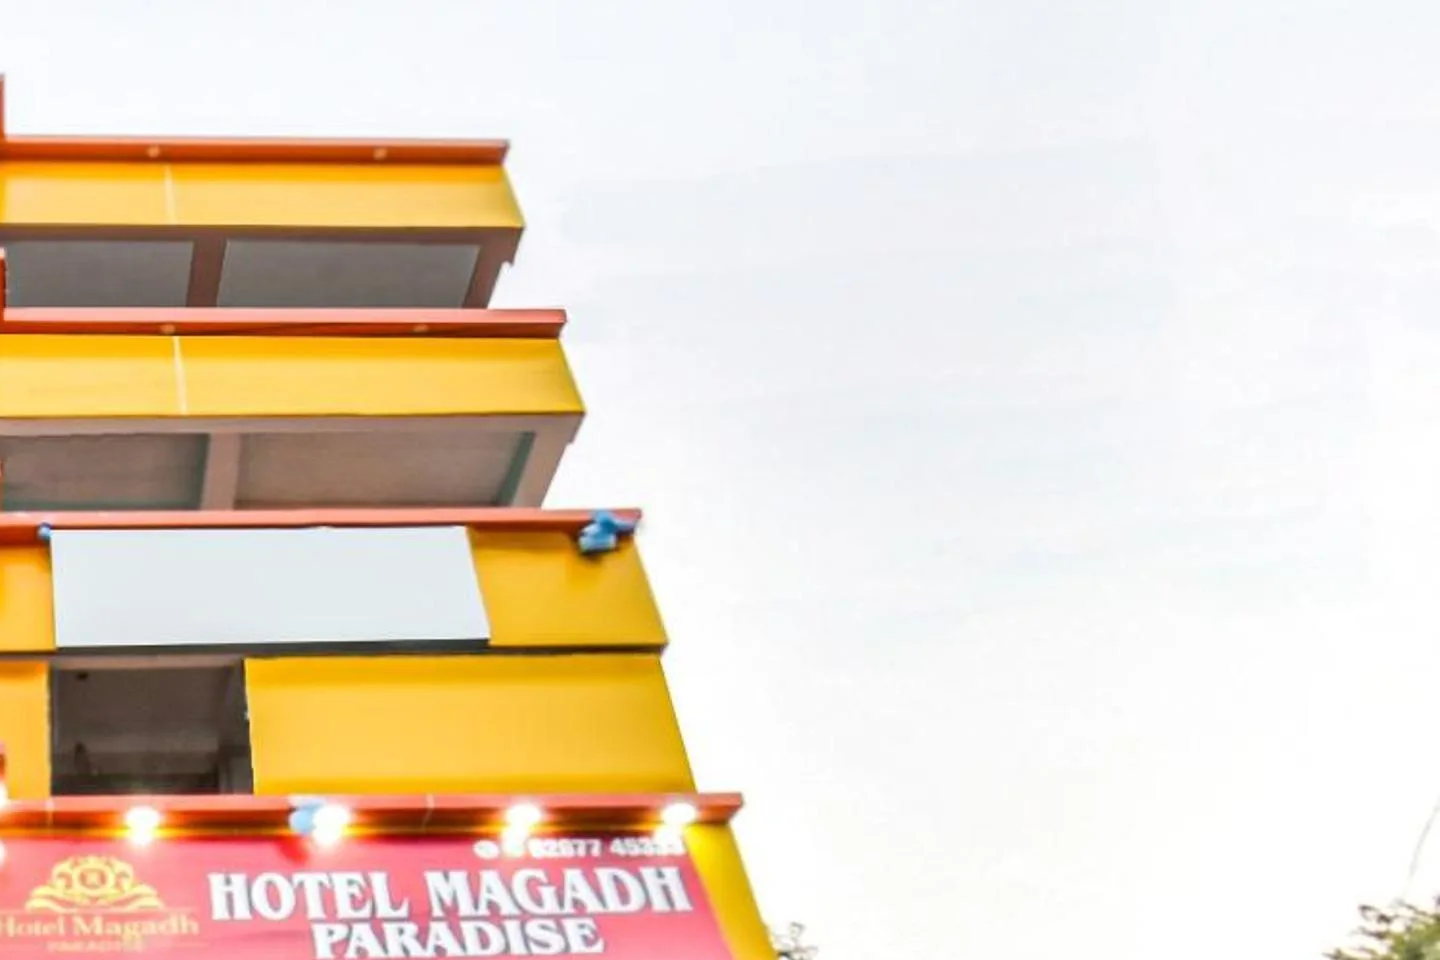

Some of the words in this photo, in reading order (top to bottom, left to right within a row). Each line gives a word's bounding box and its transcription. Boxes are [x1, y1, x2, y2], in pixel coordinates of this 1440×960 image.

[208, 871, 409, 921] HOTEL
[424, 866, 693, 917] MAGADH
[73, 914, 200, 942] Magadh
[311, 917, 605, 960] PARADISE
